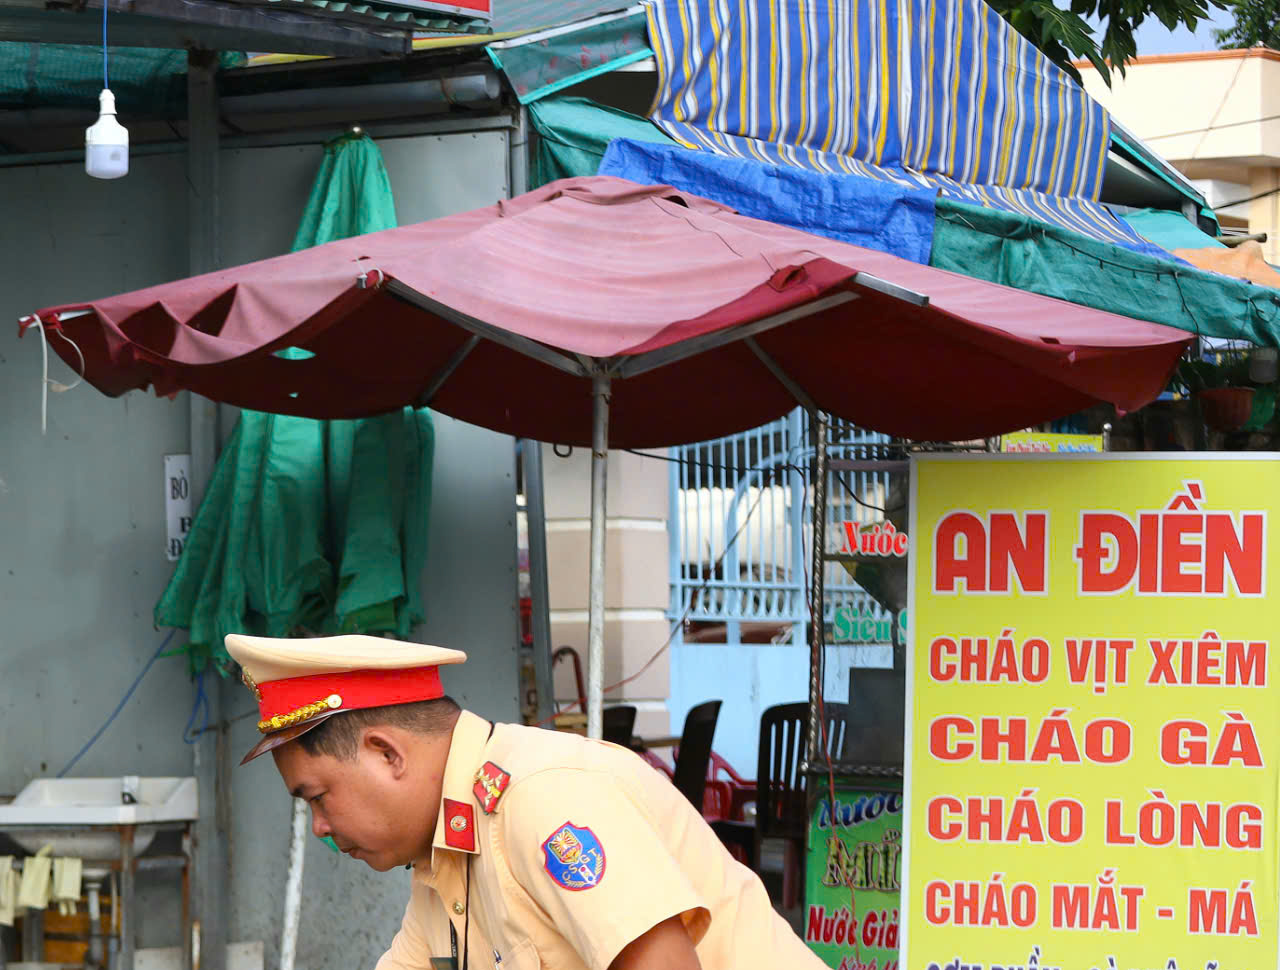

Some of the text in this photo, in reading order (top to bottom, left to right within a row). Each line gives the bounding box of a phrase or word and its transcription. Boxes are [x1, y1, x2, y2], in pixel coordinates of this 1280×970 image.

[933, 481, 1265, 596] AN ĐIỀN
[929, 628, 1268, 694] CHÁO VỊT XIÊM
[929, 709, 1264, 768] CHÁO GÀ
[927, 789, 1263, 850] CHÁO LÒNG
[925, 874, 1037, 928] CHÁO
[1052, 869, 1145, 931] MẮT
[1188, 881, 1260, 936] MÁ
